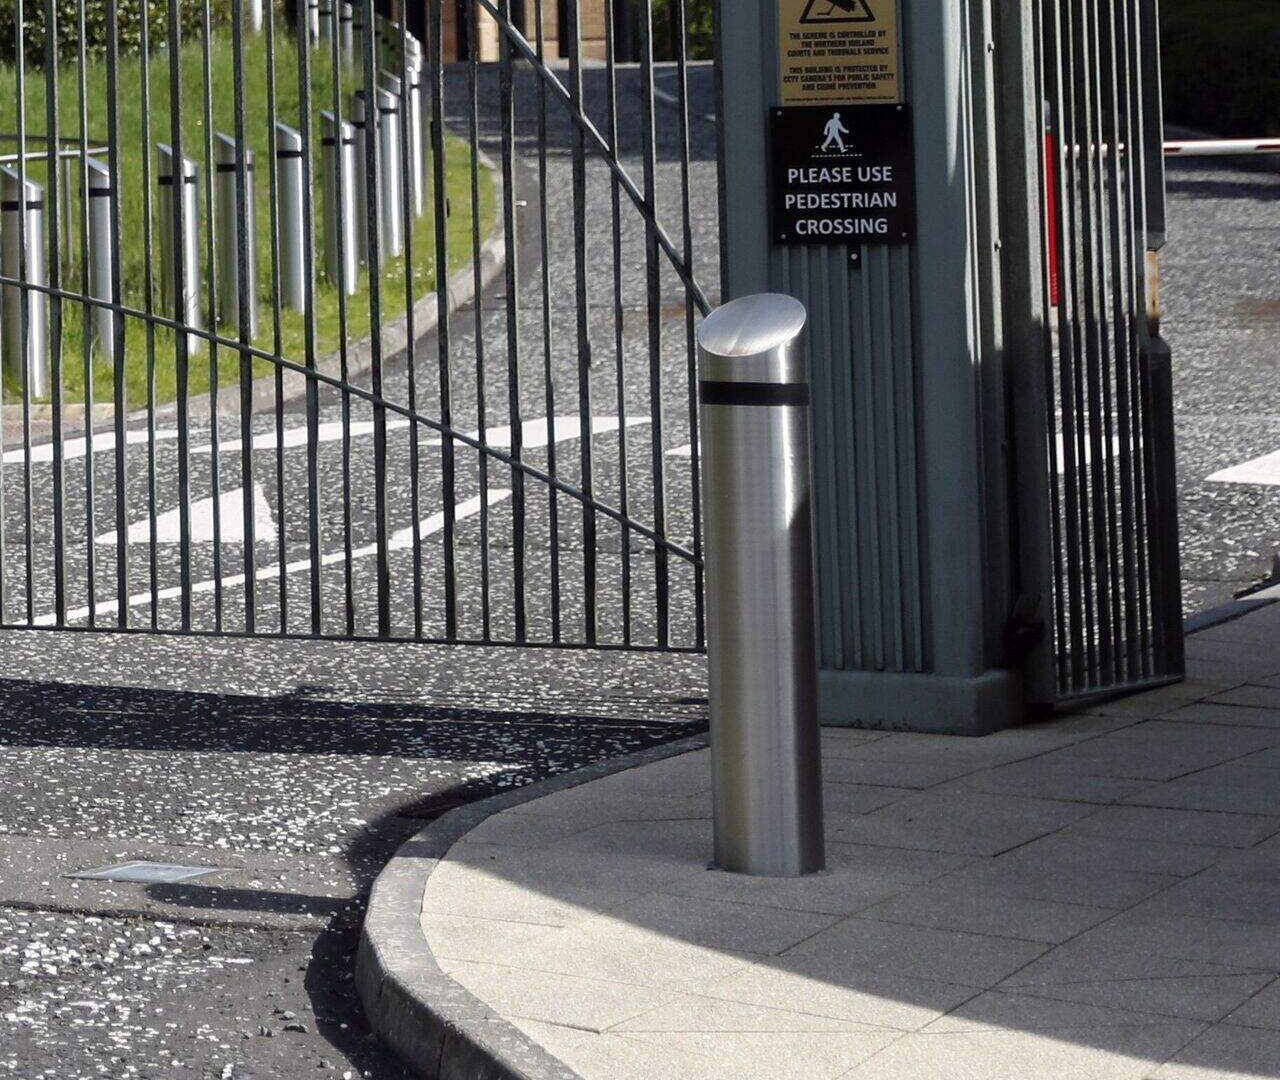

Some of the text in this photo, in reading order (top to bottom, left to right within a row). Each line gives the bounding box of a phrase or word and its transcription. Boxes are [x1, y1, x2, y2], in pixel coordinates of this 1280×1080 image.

[790, 32, 800, 40] THE
[783, 75, 799, 83] CCTV
[834, 73, 846, 81] FOR
[847, 73, 870, 81] PUBLIC
[871, 72, 894, 80] SAFETY
[788, 166, 892, 184] PLEASE USE
[785, 192, 897, 209] PEDESTRIAN
[795, 218, 888, 235] CROSSING
